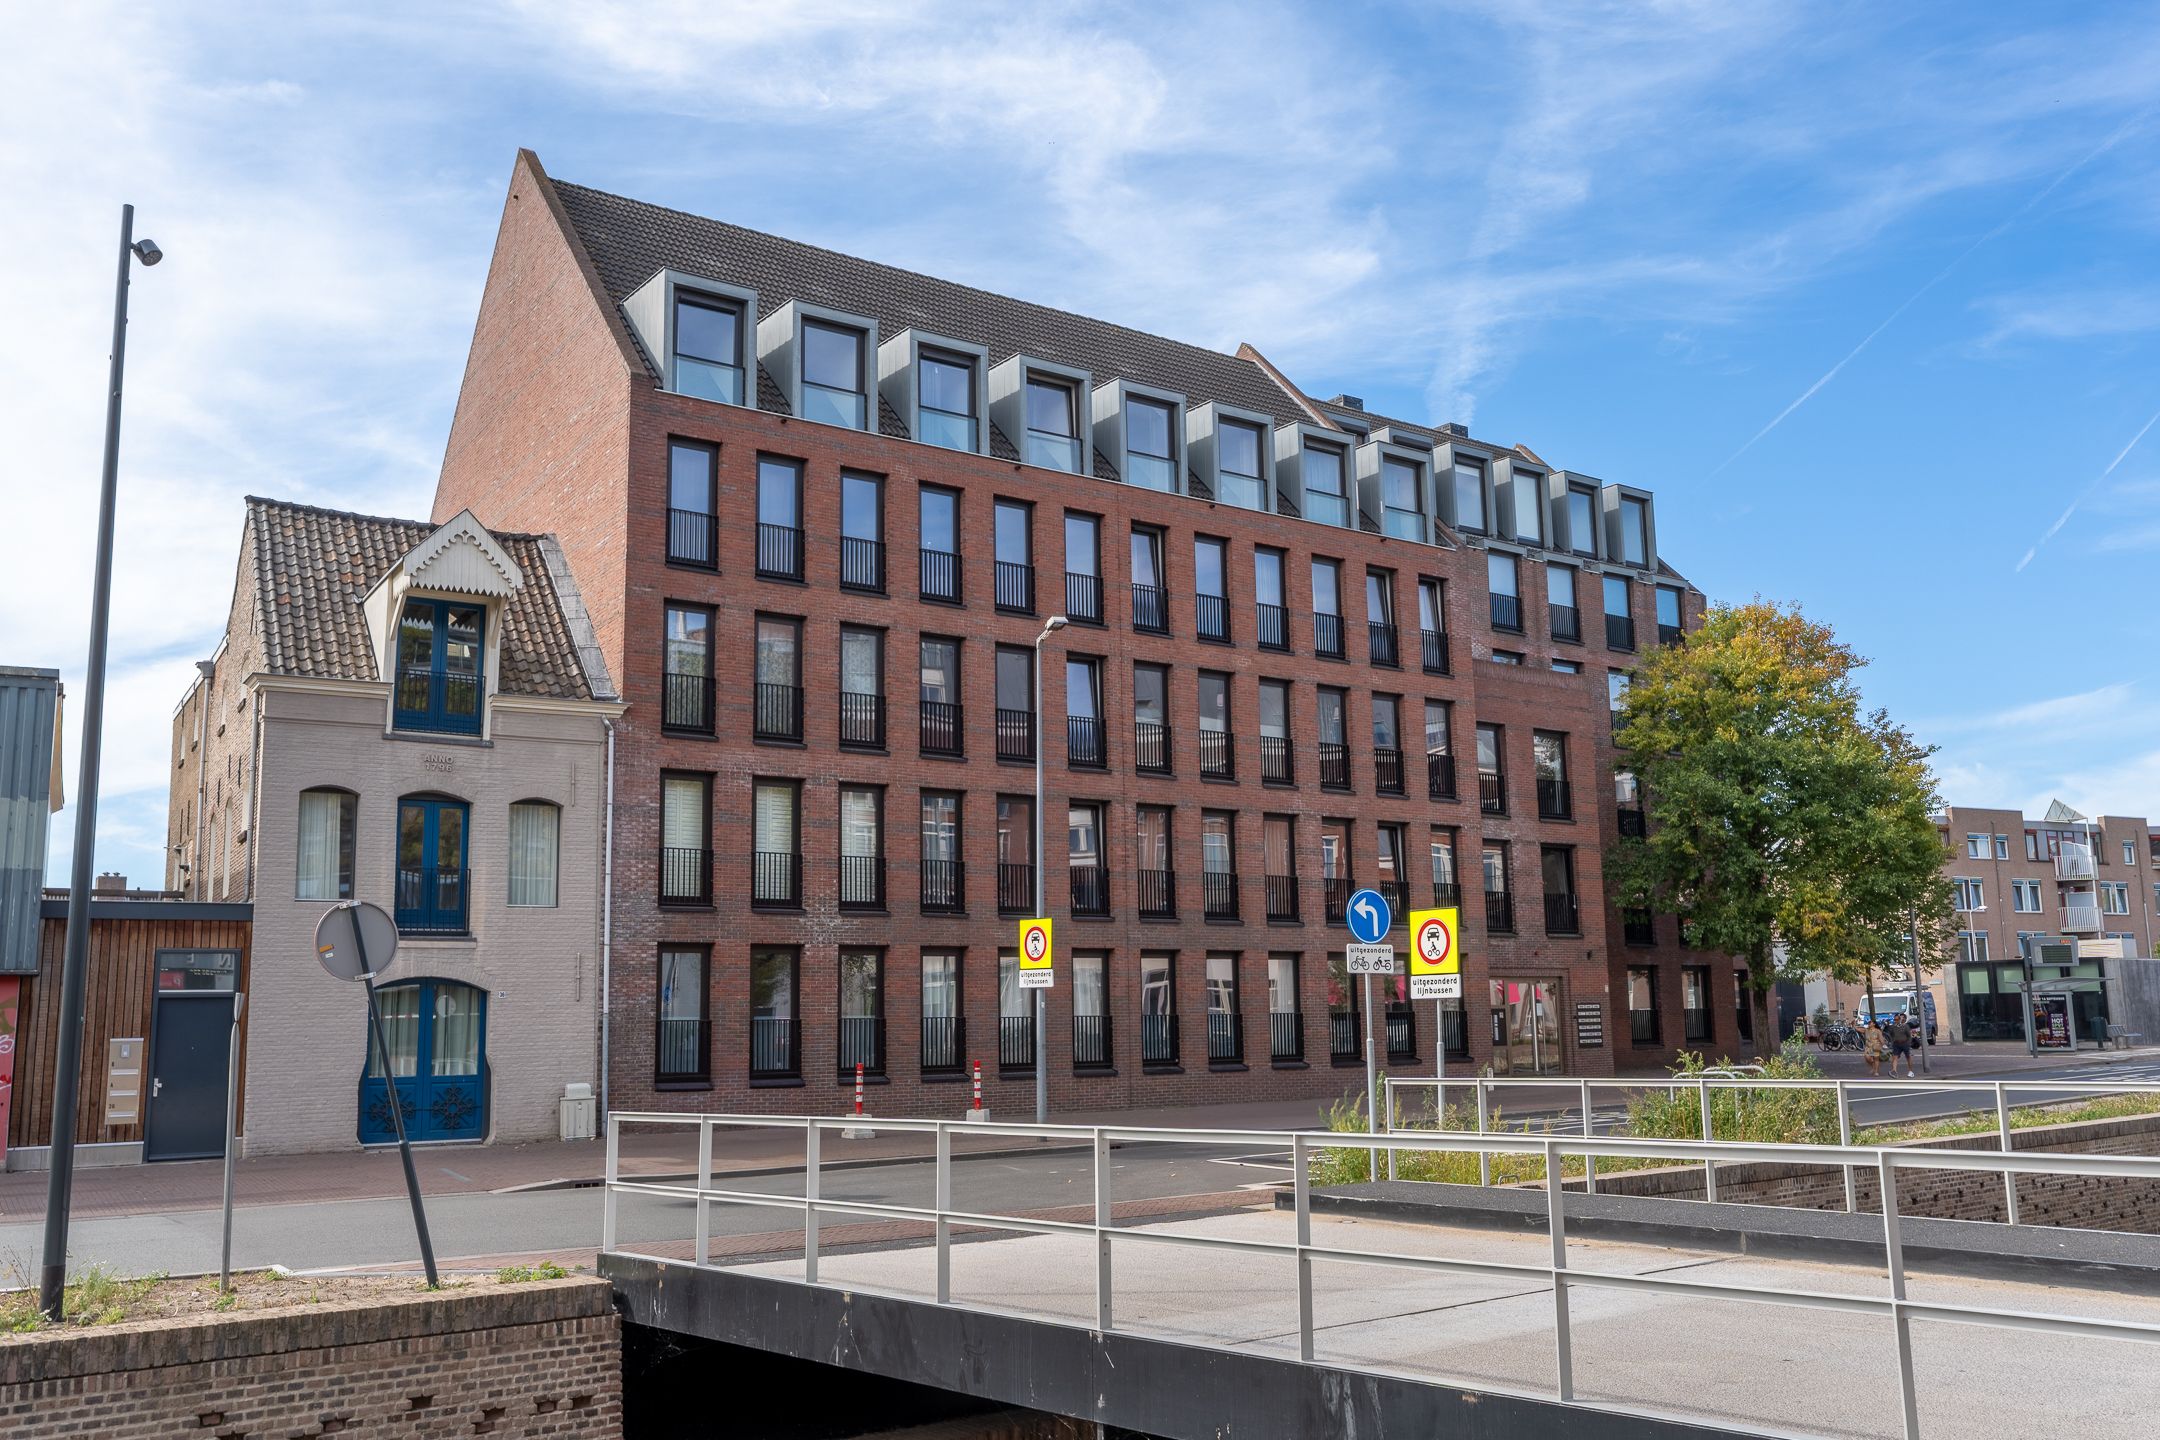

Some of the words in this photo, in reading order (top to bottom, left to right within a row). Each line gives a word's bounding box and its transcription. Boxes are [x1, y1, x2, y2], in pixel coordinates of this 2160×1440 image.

[424, 754, 454, 764] ANNO
[1412, 977, 1458, 987] uitgezonderd
[1417, 987, 1453, 996] lijnbussen
